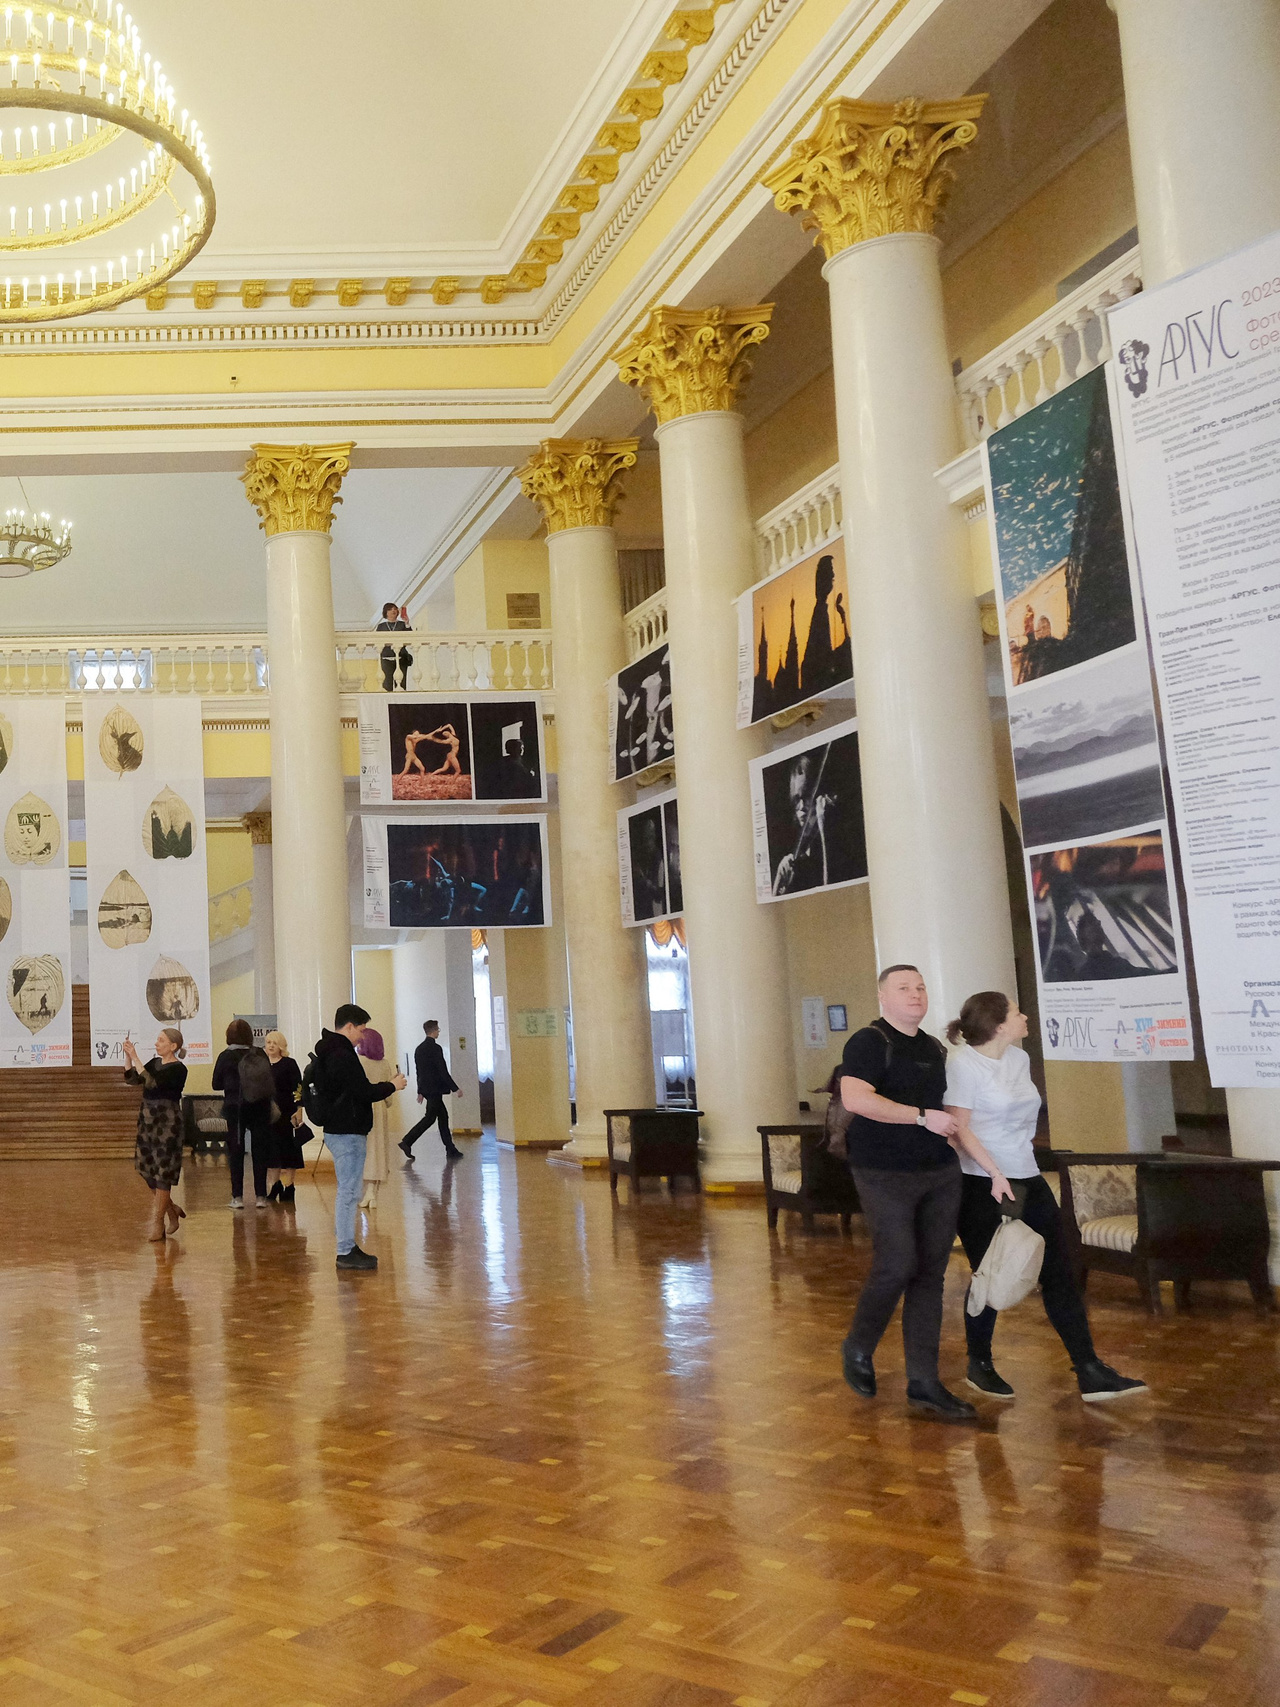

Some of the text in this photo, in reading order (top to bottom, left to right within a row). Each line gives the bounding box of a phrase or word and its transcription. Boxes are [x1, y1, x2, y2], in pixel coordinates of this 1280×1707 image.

[1158, 300, 1240, 387] АРГУС
[1221, 401, 1269, 424] Фотография
[1208, 424, 1233, 439] третий
[1236, 419, 1249, 429] раз
[1251, 410, 1274, 424] среди
[1210, 570, 1229, 580] 2023
[1232, 565, 1247, 576] году
[1189, 616, 1222, 630] конкурса
[1236, 608, 1259, 619] место
[1232, 900, 1263, 909] Конкурс
[1240, 910, 1268, 918] рамках
[1235, 920, 1264, 929] родного
[1237, 930, 1270, 939] водитель
[1245, 989, 1274, 998] Русское
[1062, 1017, 1098, 1048] АРГУС
[1215, 1043, 1271, 1054] PHOTOVISA
